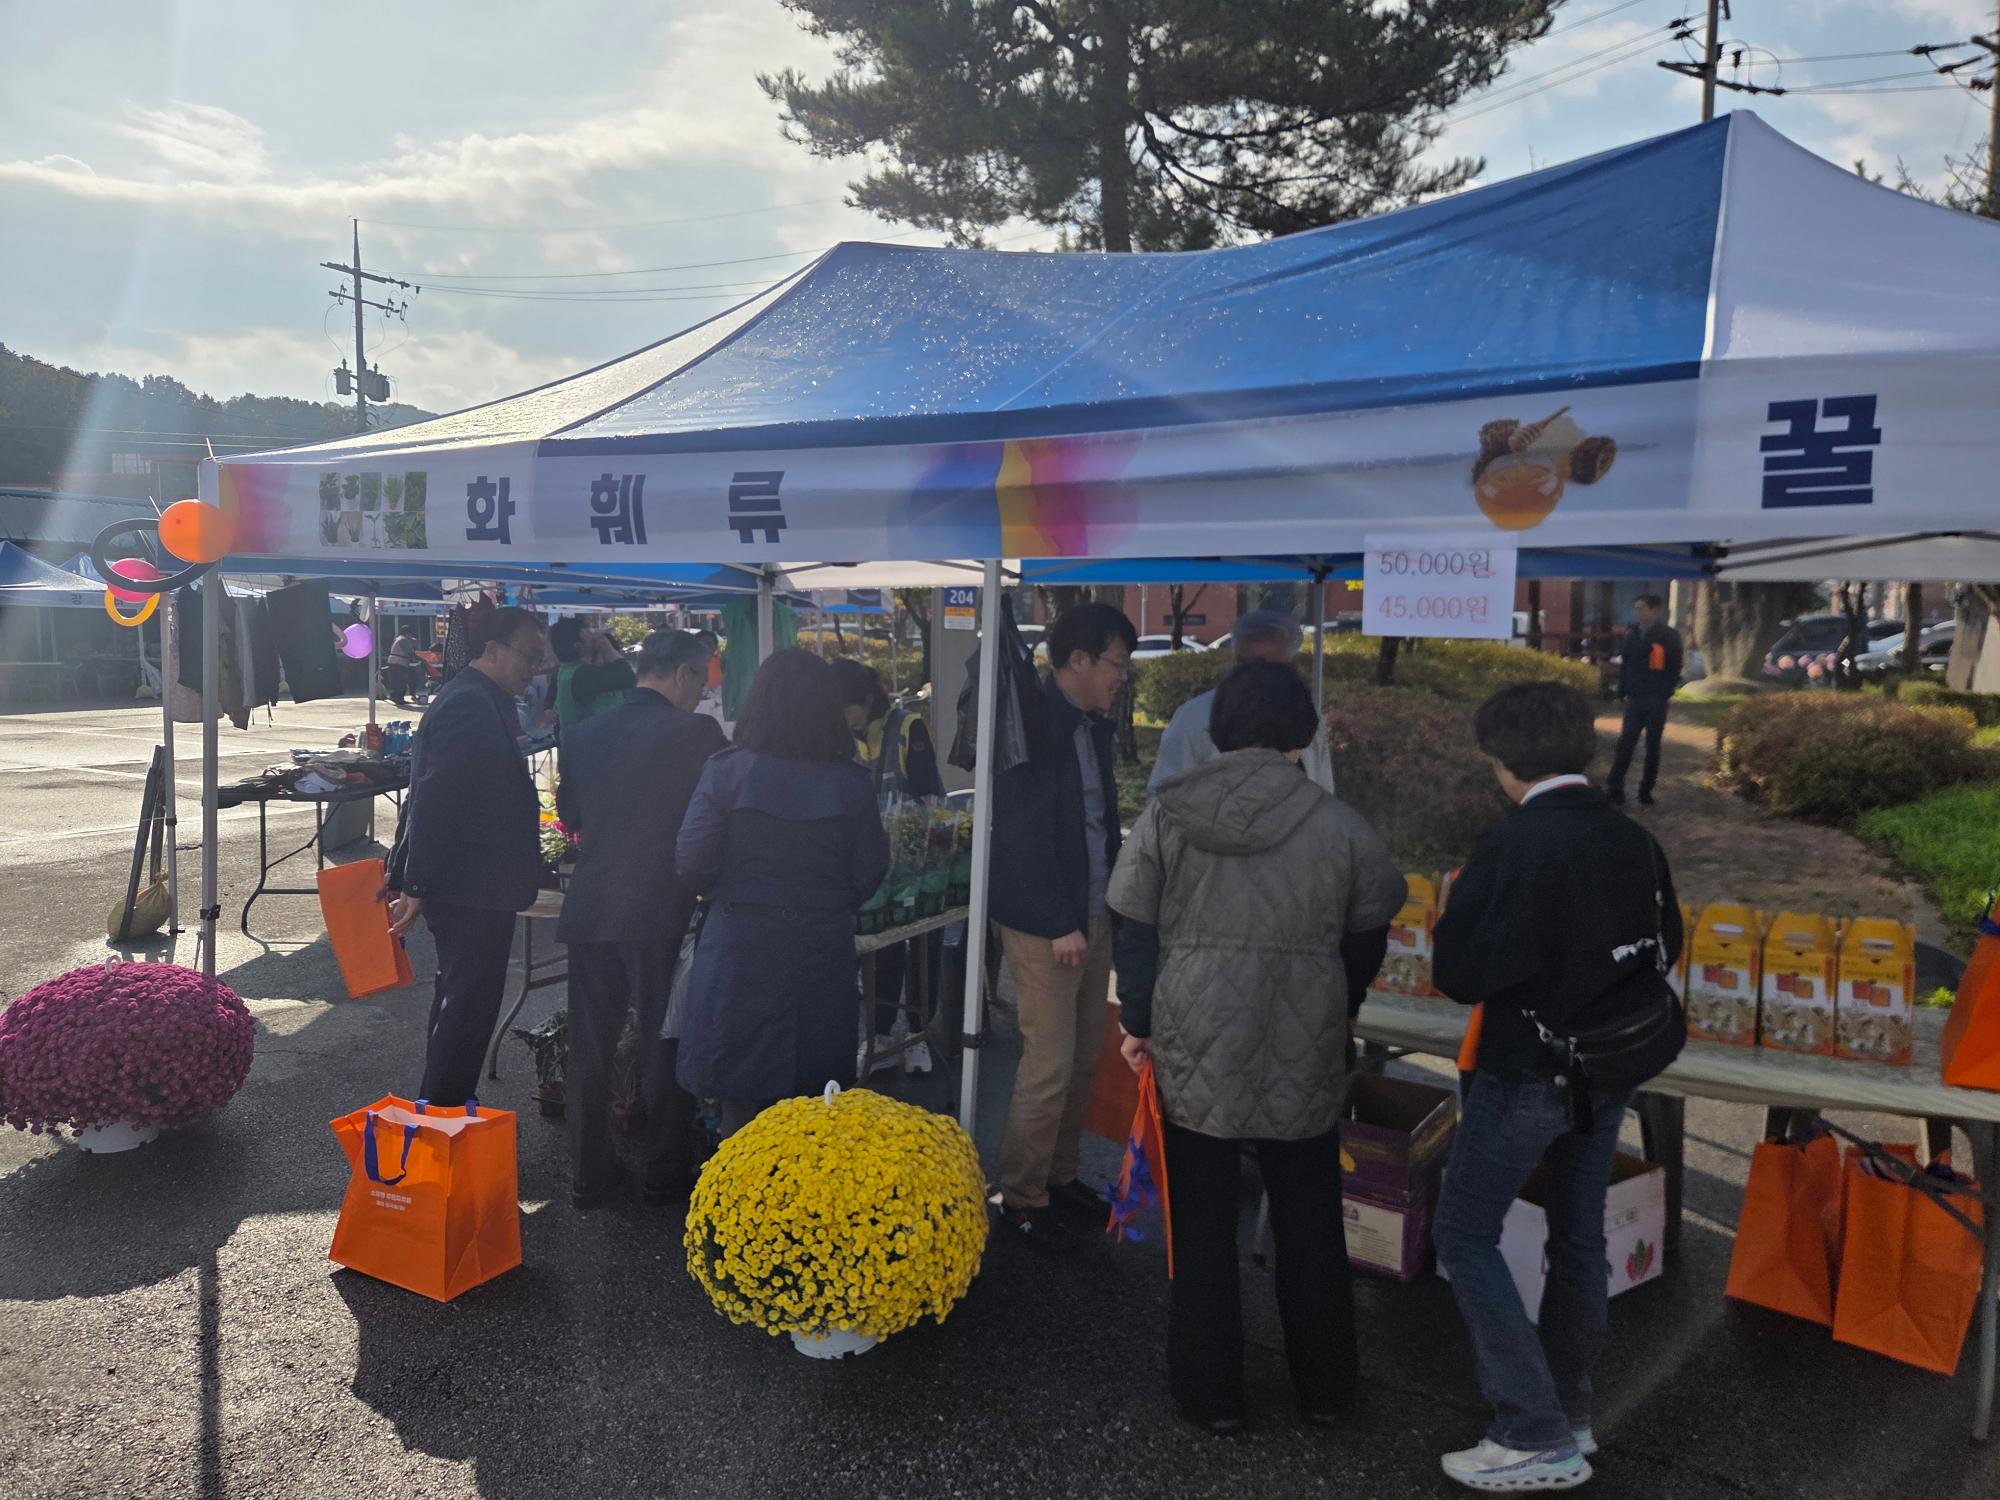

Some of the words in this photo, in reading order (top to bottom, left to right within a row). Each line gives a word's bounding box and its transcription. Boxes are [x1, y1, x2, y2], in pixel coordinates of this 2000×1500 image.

[1760, 394, 1882, 509] 꿀
[466, 475, 516, 545] 화
[590, 473, 648, 545] 훼
[728, 471, 787, 544] 류
[950, 589, 974, 605] 204
